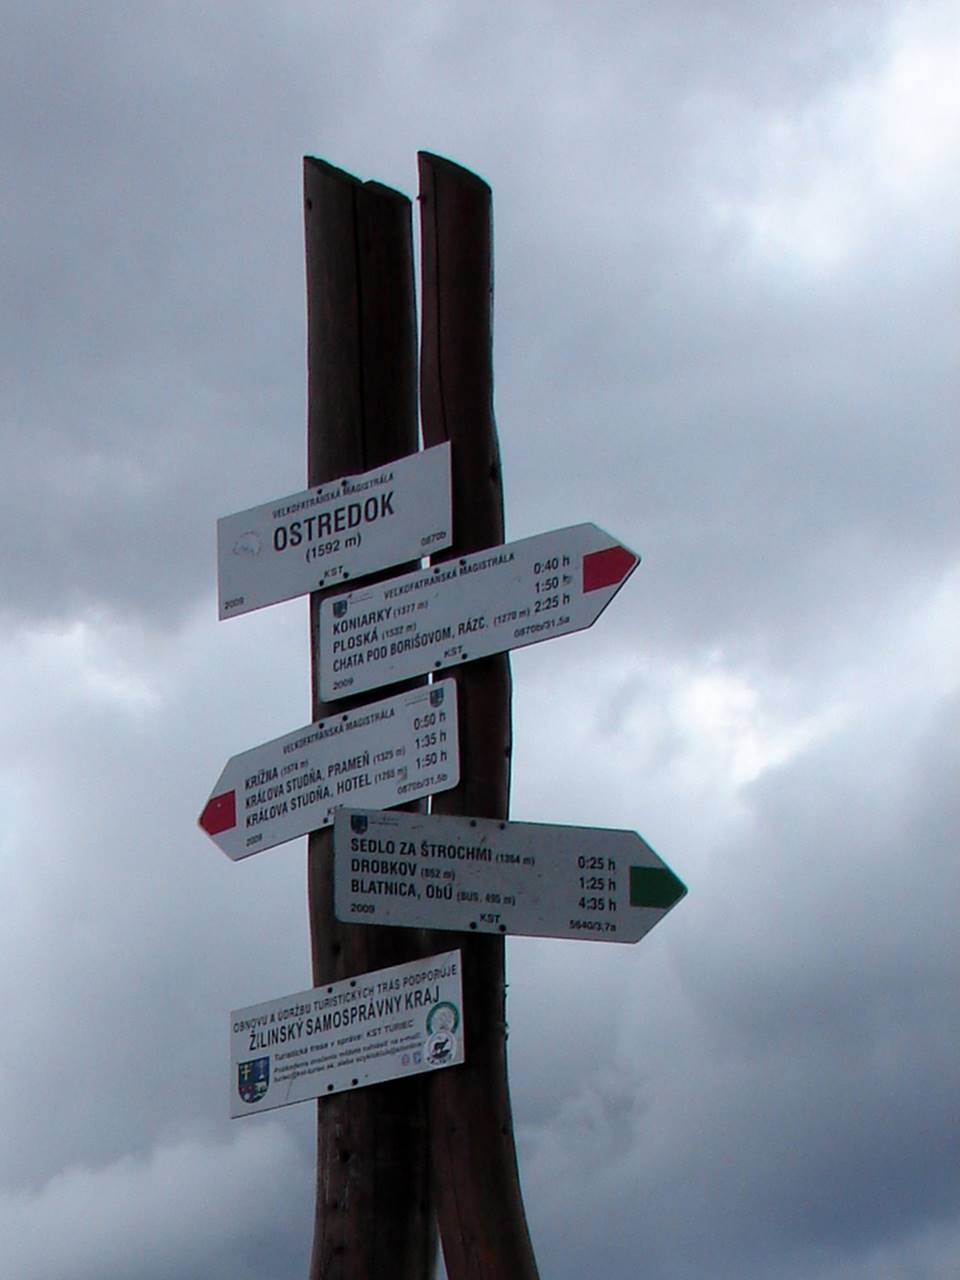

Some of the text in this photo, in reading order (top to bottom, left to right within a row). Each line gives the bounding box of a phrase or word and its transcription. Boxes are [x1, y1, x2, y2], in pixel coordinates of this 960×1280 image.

[273, 491, 395, 552] OSTREDOK
[306, 532, 362, 563] (1592 m)
[459, 553, 515, 577] MAGISTRÁLA
[533, 555, 570, 575] 0:40 h
[535, 574, 571, 593] 1:50 h
[534, 593, 570, 613] 2:25 h
[333, 607, 392, 635] KONIARKY
[333, 626, 378, 653] PLOSKÁ
[333, 655, 364, 673] CHATA
[366, 646, 388, 662] POD
[414, 711, 446, 730] 0:50 h
[416, 730, 447, 749] 1:35 h
[328, 750, 370, 777] PRAMEŇ
[416, 749, 447, 769] 1:50 h
[337, 774, 371, 794] HOTEL
[351, 838, 395, 854] SEDLO
[399, 842, 416, 856] ZA
[420, 841, 492, 862] ŠTROCHMI
[351, 859, 417, 877] DROBKOV
[577, 856, 616, 870] 0:25 h
[351, 880, 421, 900] BLATNICA,
[426, 883, 453, 900] ObÚ
[579, 877, 616, 891] 1:25 h
[351, 903, 375, 914] 2009
[579, 897, 617, 911] 4:35 h
[233, 1014, 268, 1033] OBNOVU
[270, 1013, 276, 1023] A
[403, 964, 457, 988] PODPORUJE
[249, 985, 440, 1050] ŽILINSKÝ SAMOSPRÁVNY KRAJ
